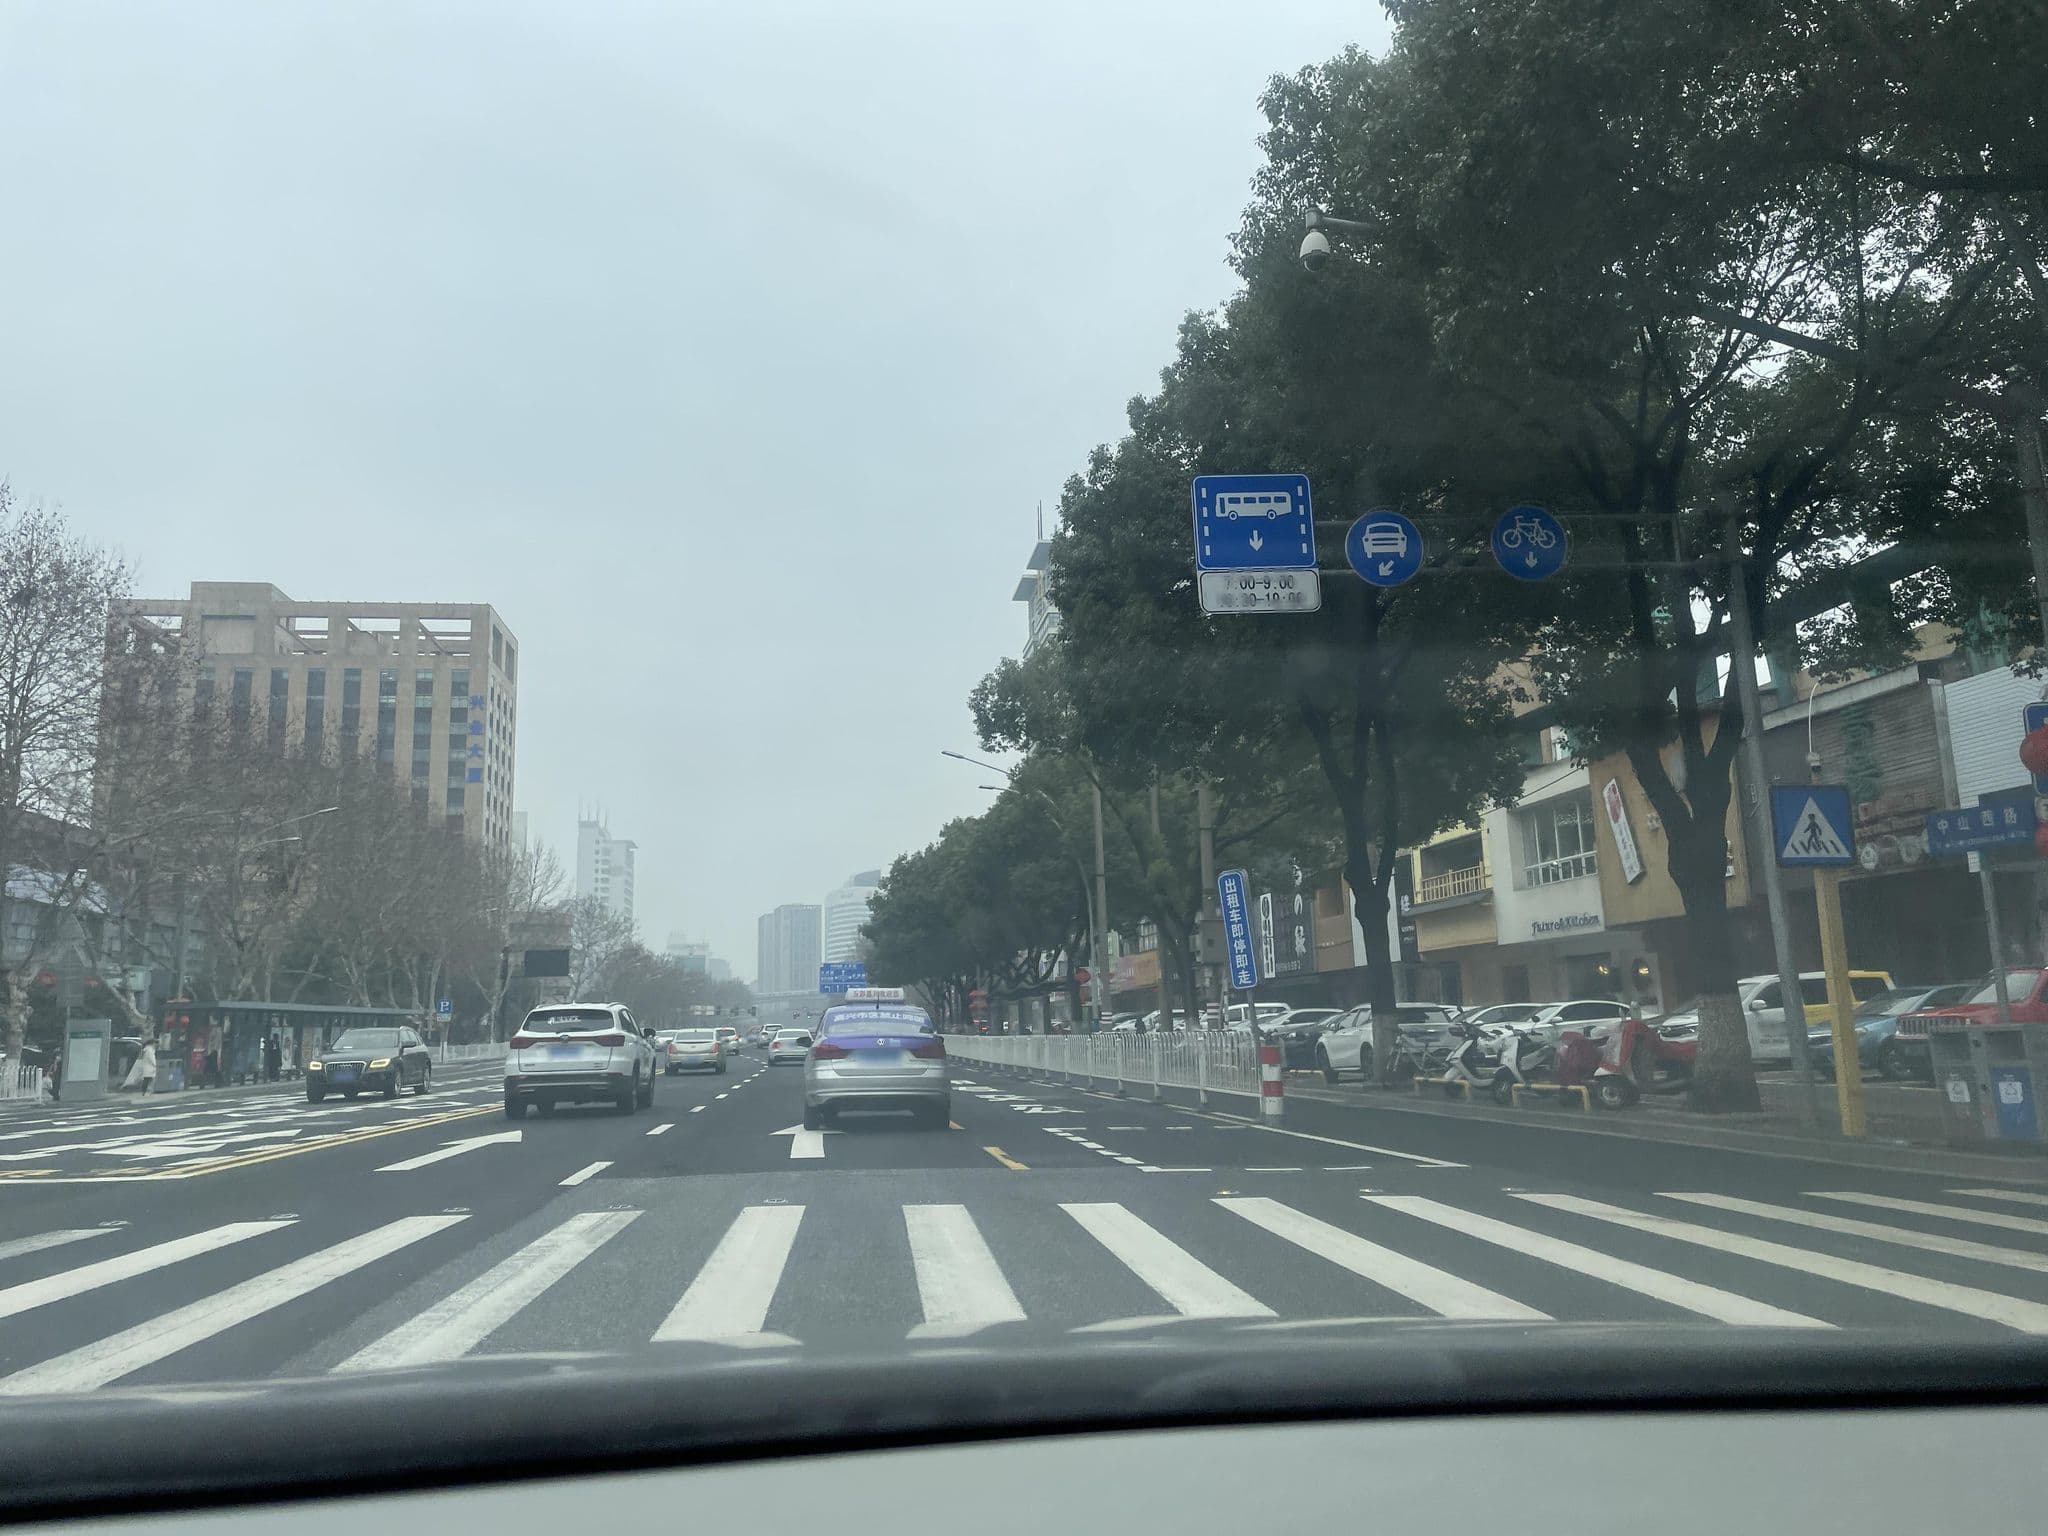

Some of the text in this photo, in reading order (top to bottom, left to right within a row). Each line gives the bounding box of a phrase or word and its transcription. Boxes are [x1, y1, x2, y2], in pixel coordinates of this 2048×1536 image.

[1936, 807, 2017, 836] 中山西路
[1224, 878, 1252, 985] 出租车即停即走
[439, 1001, 450, 1012] P
